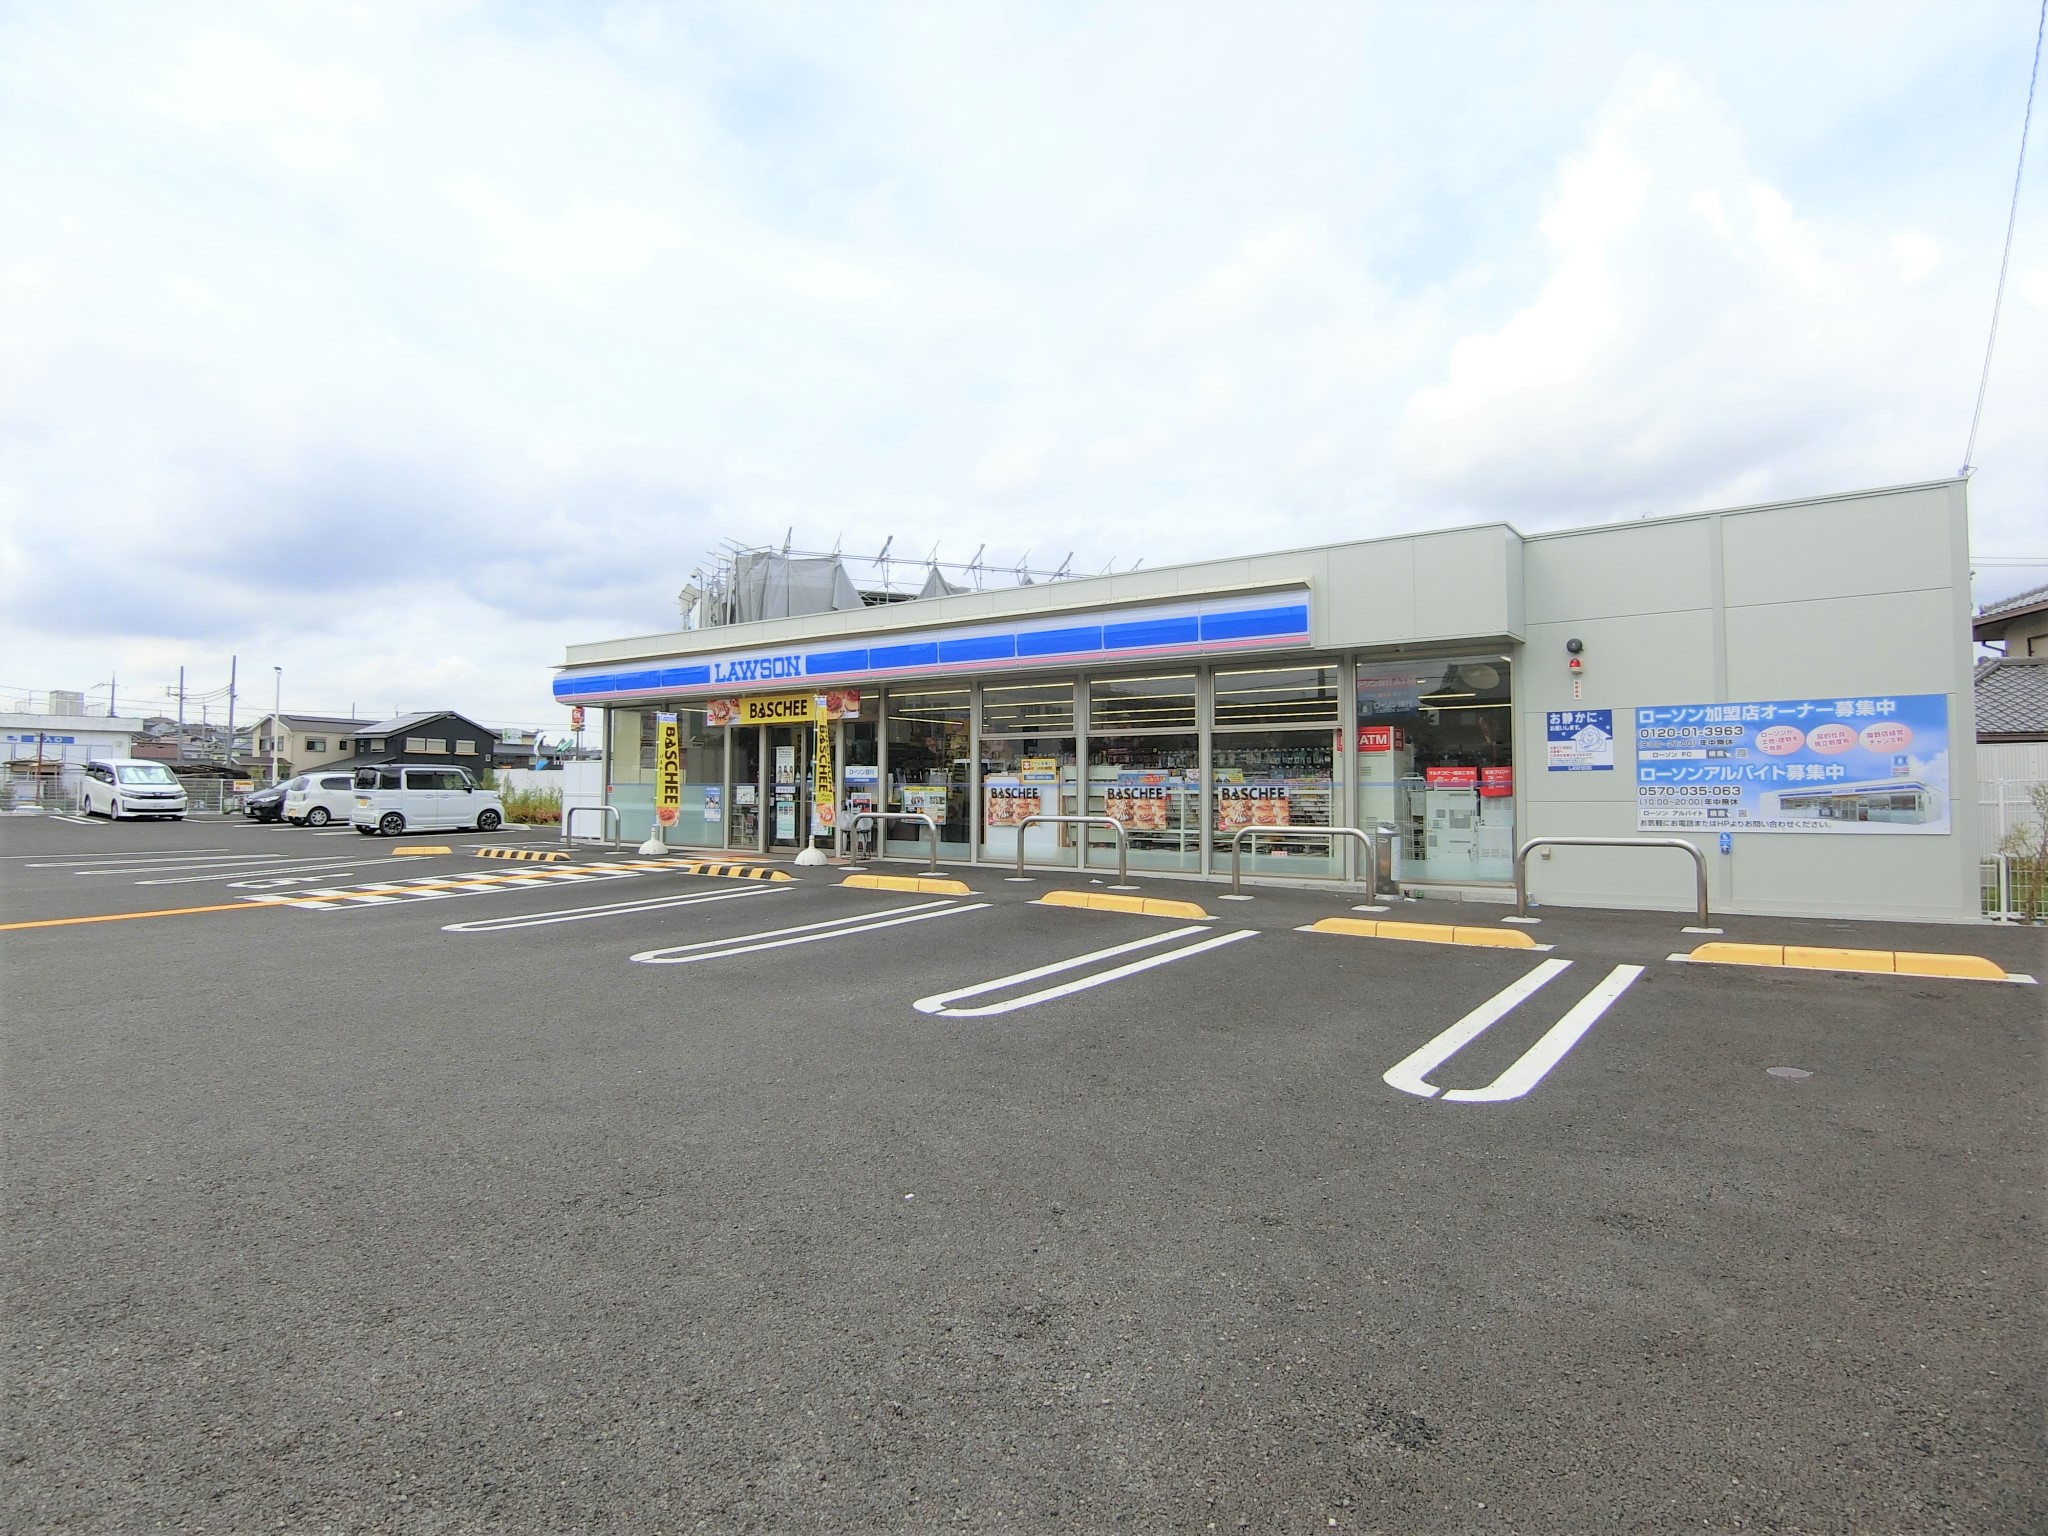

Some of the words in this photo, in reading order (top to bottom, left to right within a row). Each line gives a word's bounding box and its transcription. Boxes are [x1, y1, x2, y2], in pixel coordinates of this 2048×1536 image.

[714, 656, 801, 683] LAWSON
[750, 700, 808, 719] BASCHEE
[1639, 699, 1896, 723] ローソン加盟店オーナー募集中
[1640, 726, 1744, 738] 0120-01-3963
[1359, 734, 1388, 745] ATM
[664, 726, 679, 804] BASCHEE
[1640, 764, 1845, 782] ローソンアルバイト募集中
[991, 787, 1039, 799] BASCHEE
[1107, 787, 1163, 800] BASCHEE
[1221, 787, 1285, 800] BASCHEE
[1639, 786, 1742, 796] 0570-035-063
[1639, 819, 1832, 829] お気軽にお電話またはHPよりお問い合わせください。
